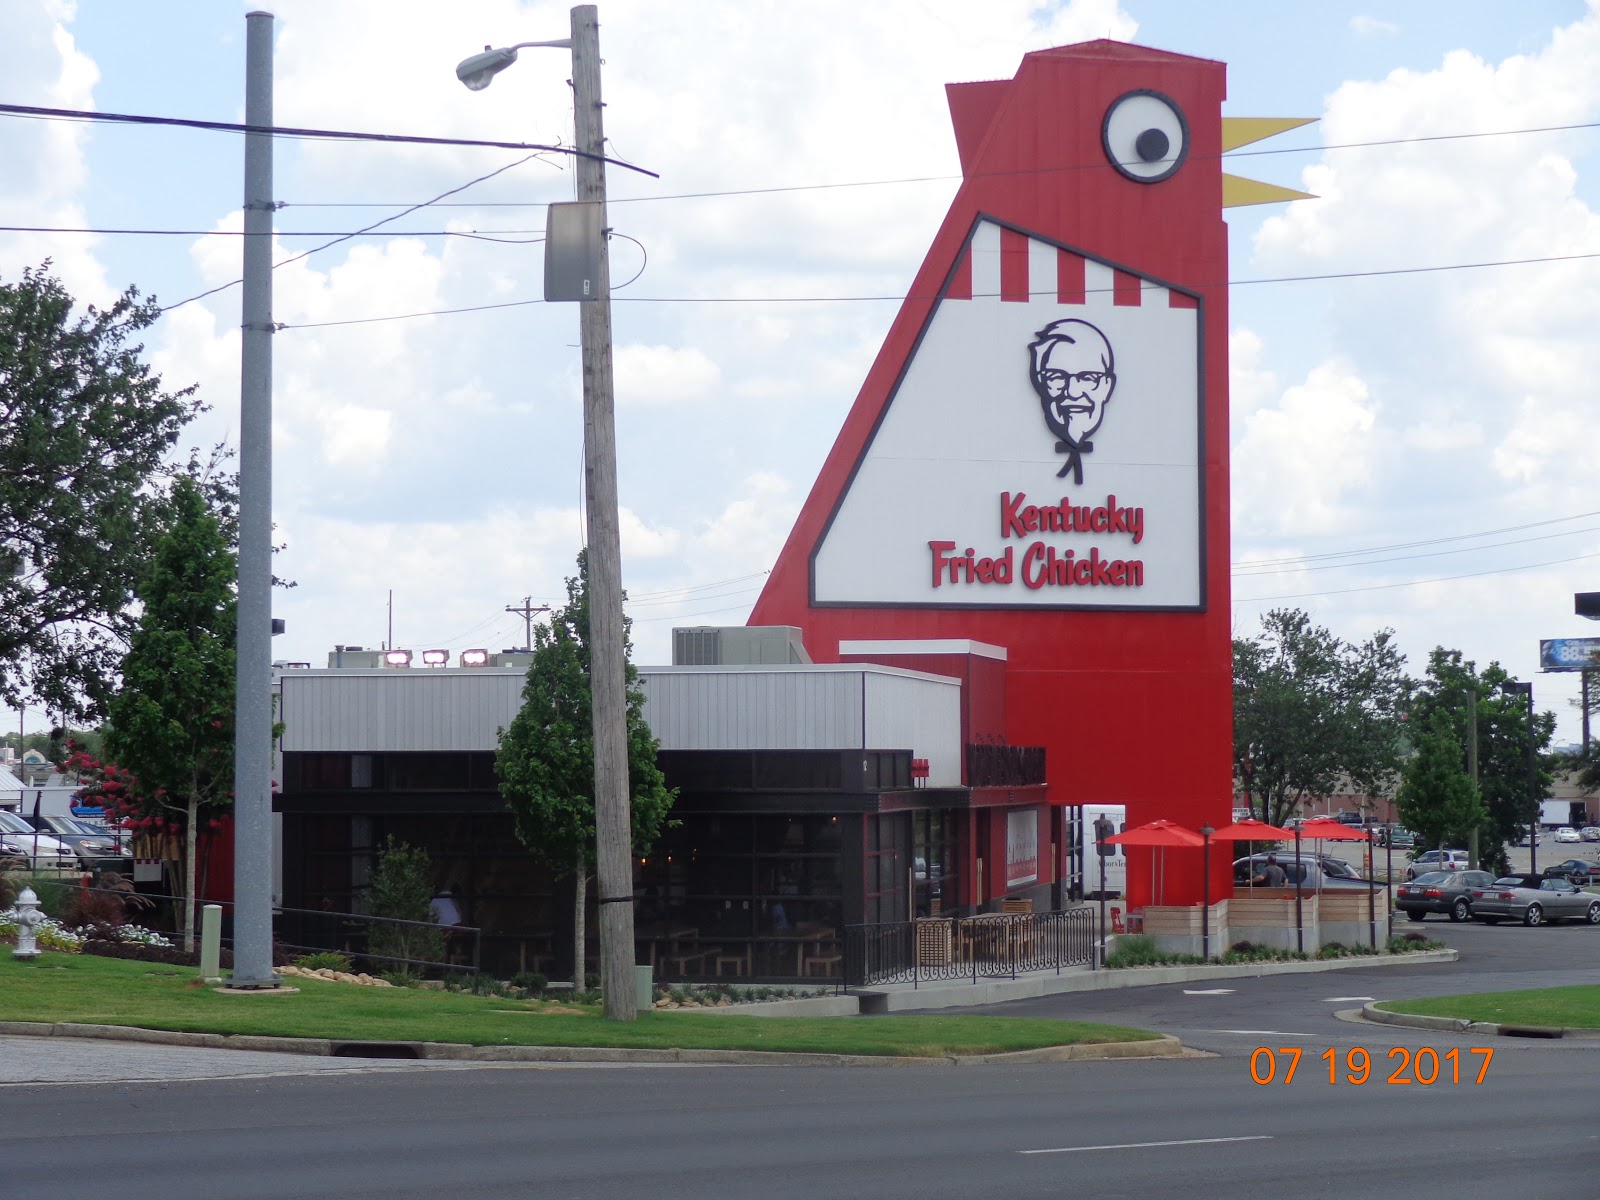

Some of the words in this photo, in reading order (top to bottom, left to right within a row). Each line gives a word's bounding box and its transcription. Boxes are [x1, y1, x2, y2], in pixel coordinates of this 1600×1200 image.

[1000, 491, 1144, 544] Kentucky
[928, 541, 1013, 588] Fried
[1021, 541, 1144, 590] Chicken
